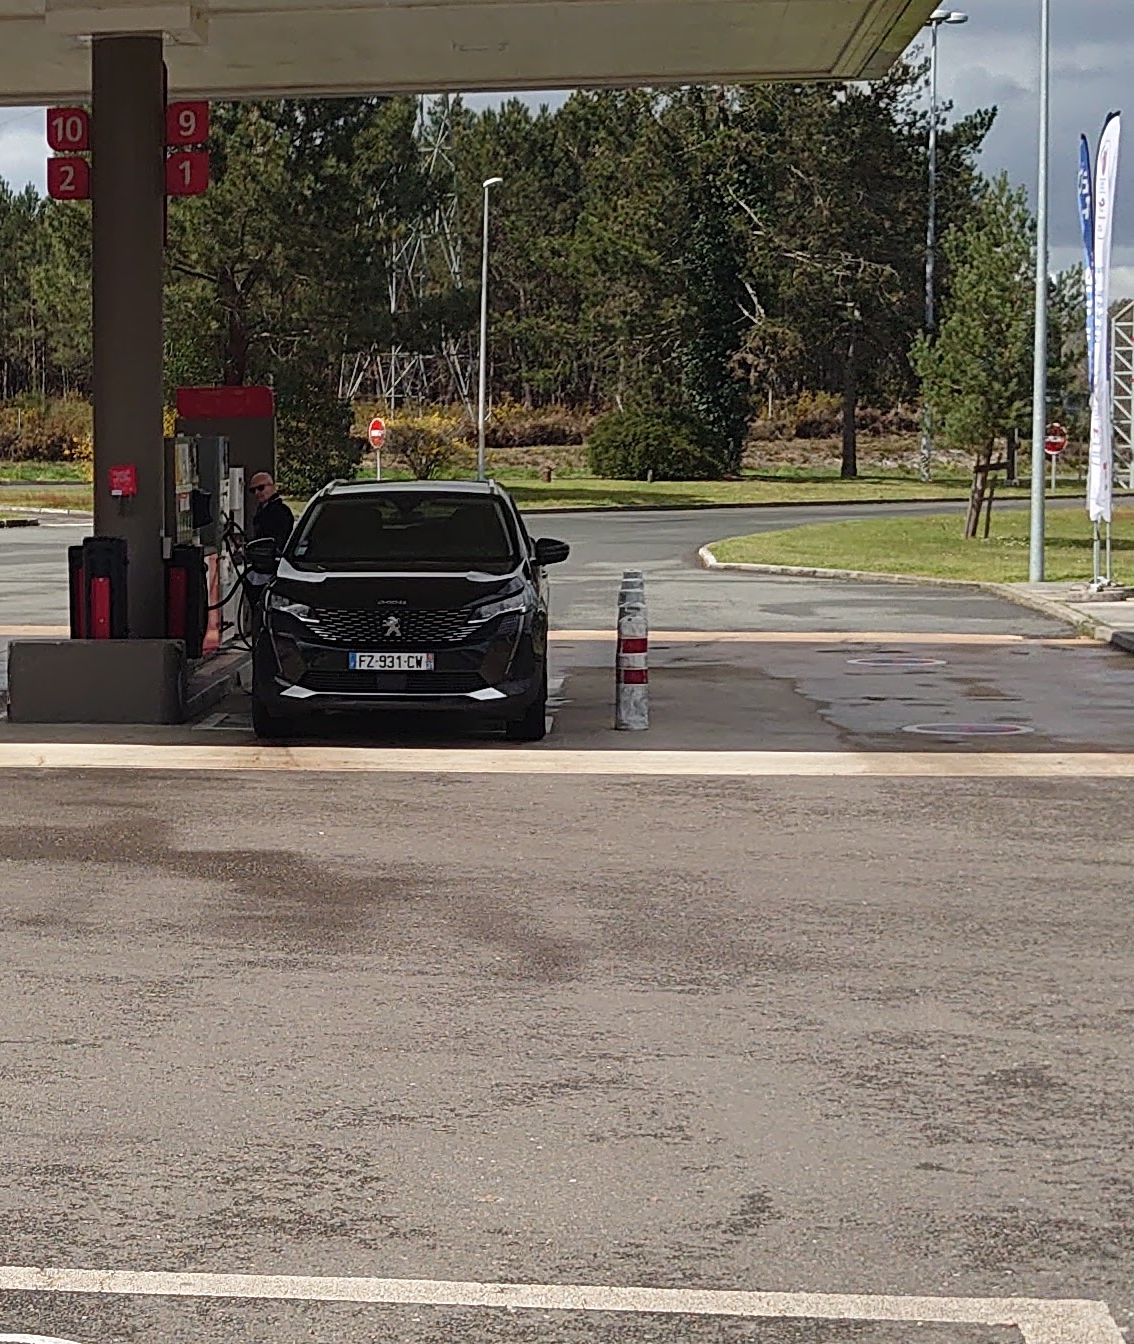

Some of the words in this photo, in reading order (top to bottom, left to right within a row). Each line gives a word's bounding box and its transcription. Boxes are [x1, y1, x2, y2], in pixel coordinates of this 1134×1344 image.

[52, 116, 83, 143] 10
[179, 110, 196, 137] 9
[59, 165, 76, 192] 2
[178, 160, 192, 186] 1
[358, 654, 423, 669] FZ-931-CW
